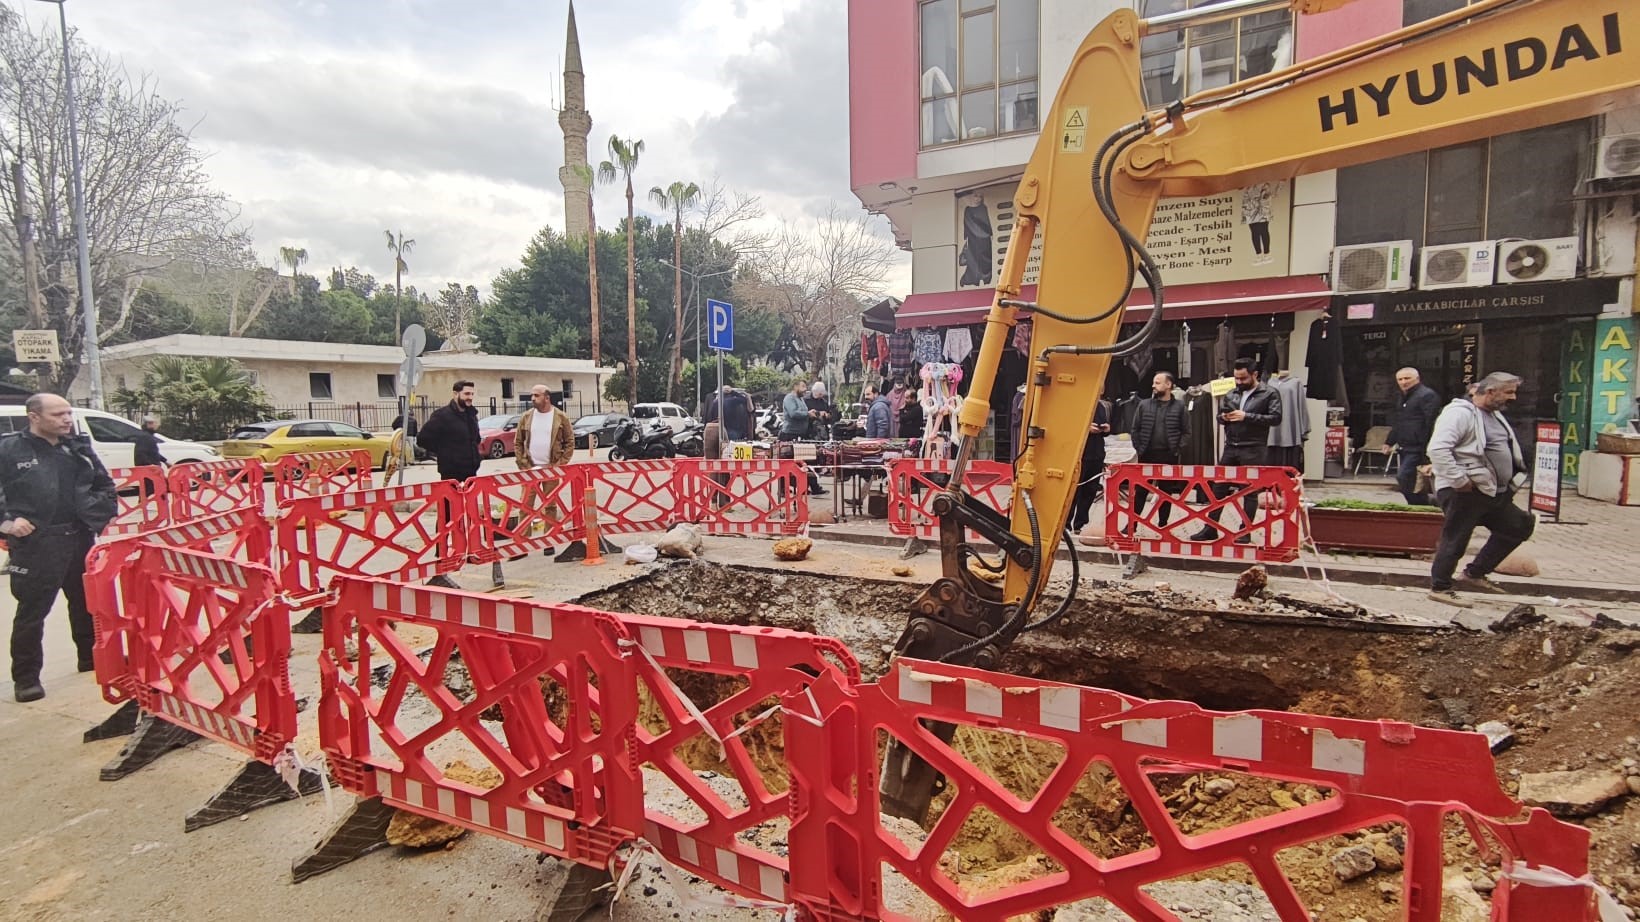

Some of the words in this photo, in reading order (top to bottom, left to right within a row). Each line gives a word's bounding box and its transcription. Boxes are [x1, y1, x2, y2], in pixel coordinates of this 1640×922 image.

[1318, 12, 1622, 132] HYUNDAI
[1156, 201, 1195, 212] mzem
[1199, 196, 1233, 206] Suyu
[1151, 215, 1172, 225] naze
[1174, 205, 1233, 222] Malzemeleri
[1147, 225, 1184, 237] eccade
[1193, 219, 1233, 232] Tesbih
[1147, 240, 1172, 249] azma
[1180, 236, 1208, 247] Eşarp
[1216, 231, 1233, 244] Şal
[1198, 245, 1232, 256] Mest
[1169, 260, 1194, 269] Bone
[1202, 257, 1233, 267] Eşarp
[712, 305, 727, 344] P
[1463, 344, 1475, 384] TERZ
[1600, 326, 1632, 434] AKT
[1562, 328, 1584, 476] AKTAR
[734, 446, 745, 460] 30
